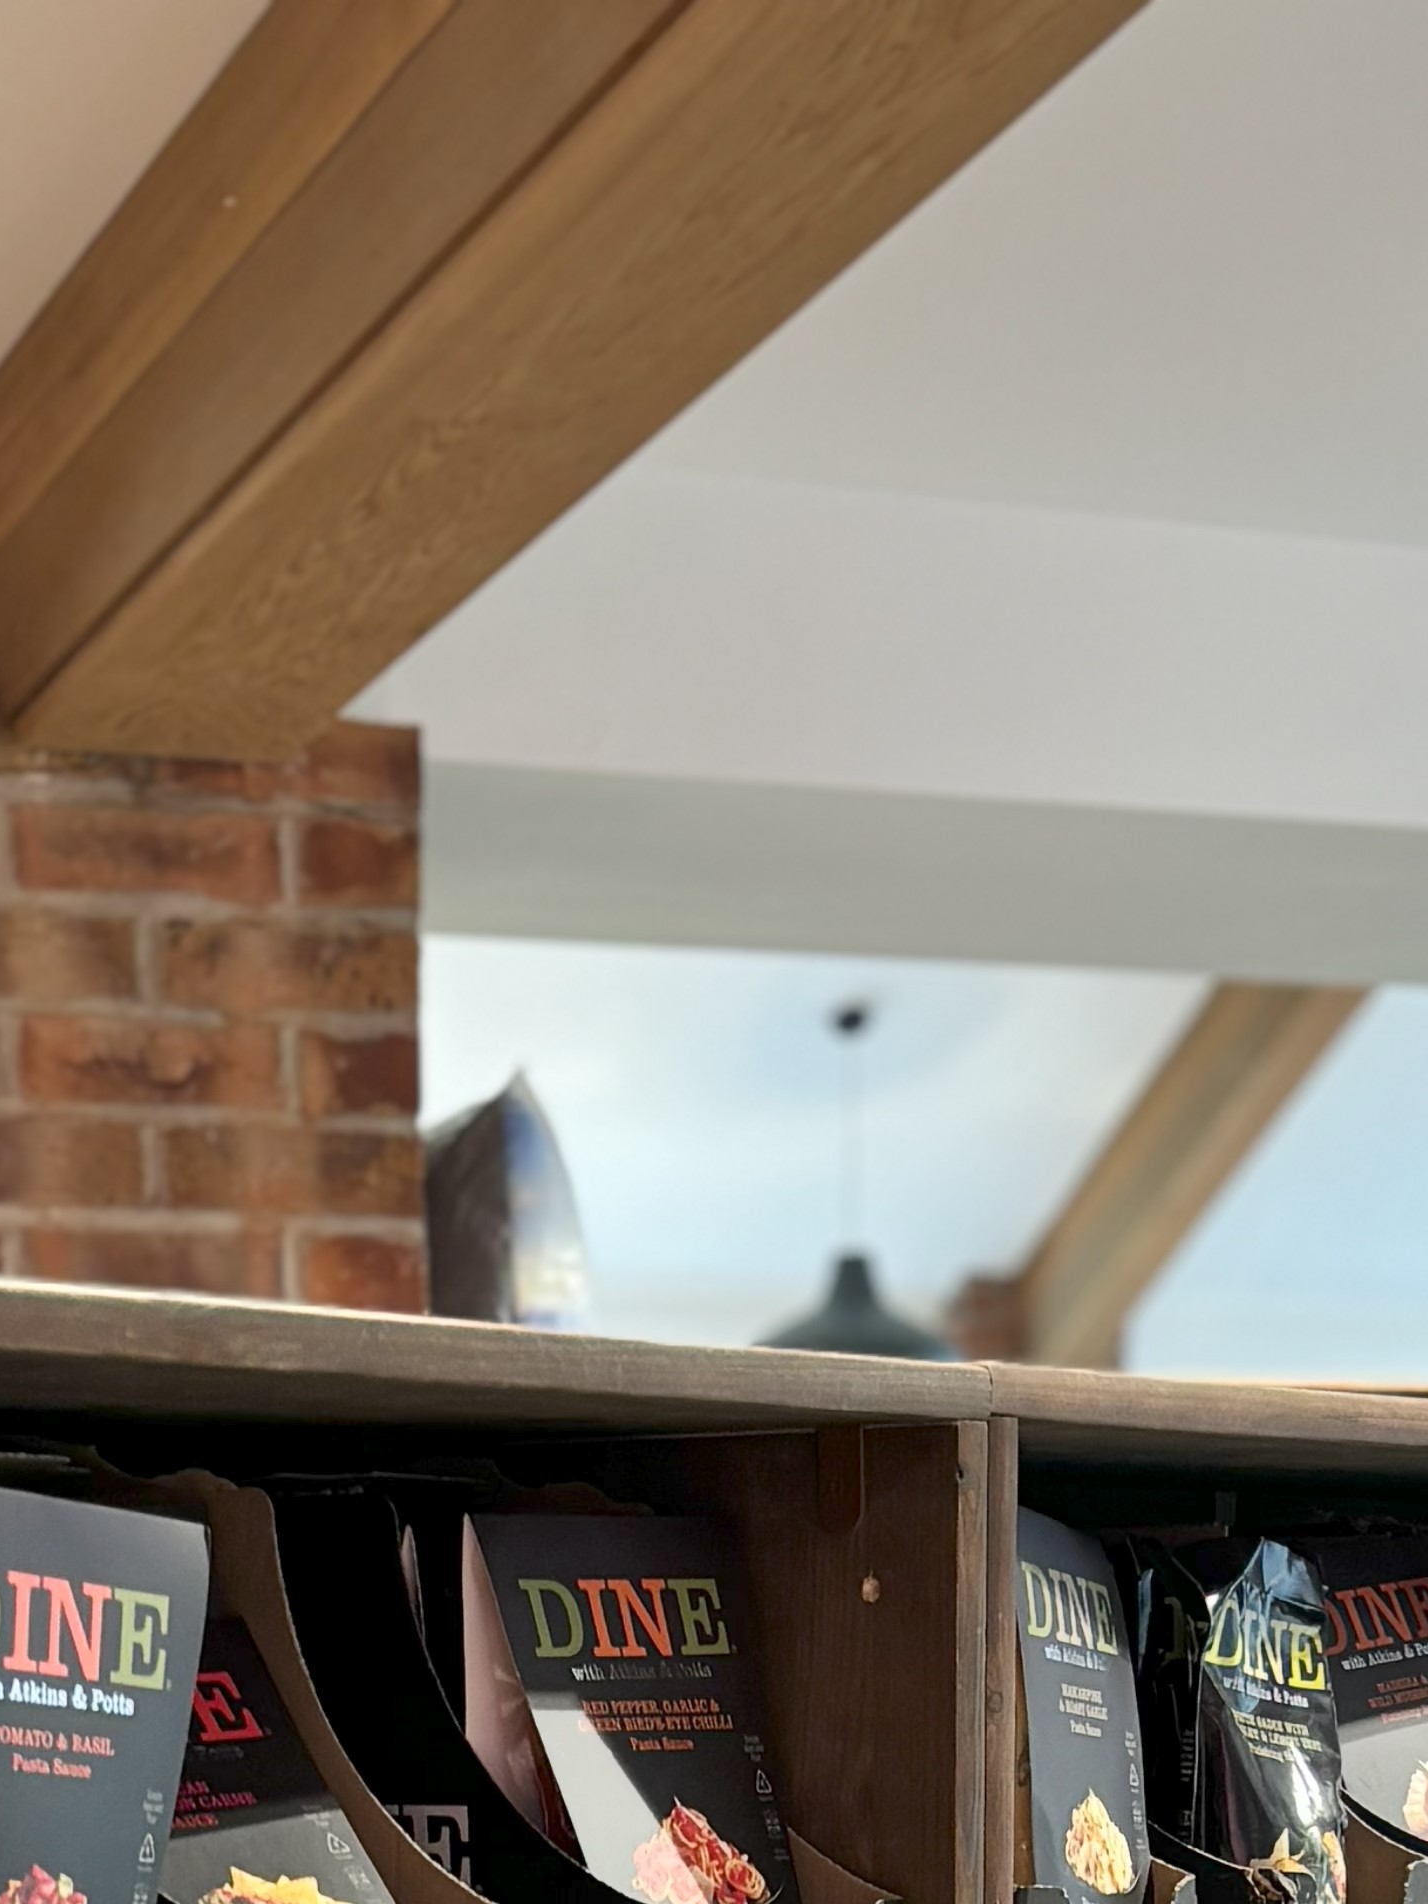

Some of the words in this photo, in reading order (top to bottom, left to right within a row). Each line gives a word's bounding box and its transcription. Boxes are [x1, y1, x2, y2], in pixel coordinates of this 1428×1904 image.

[518, 1577, 729, 1659] DINE
[1021, 1561, 1117, 1656] DINE
[1205, 1599, 1327, 1691] DINE
